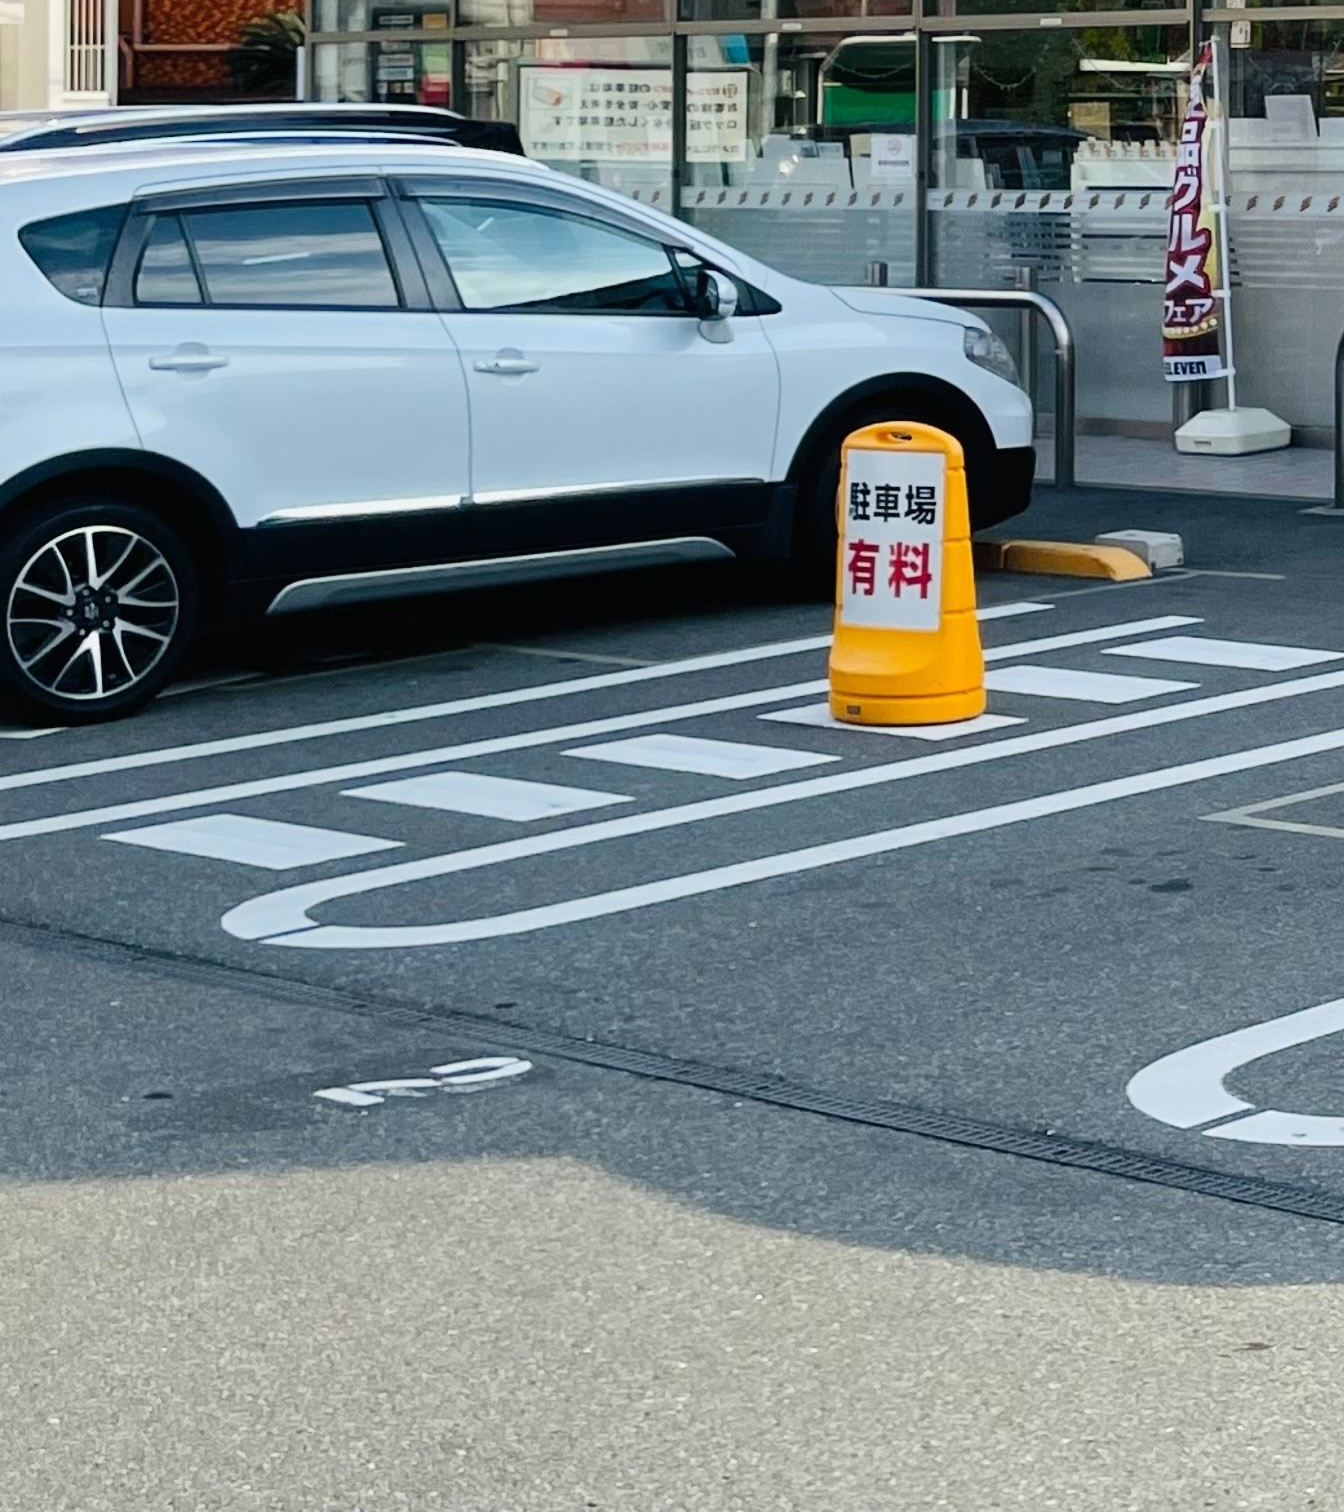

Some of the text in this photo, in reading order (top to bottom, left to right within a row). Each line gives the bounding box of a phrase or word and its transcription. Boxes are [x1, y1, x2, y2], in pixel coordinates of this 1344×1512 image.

[848, 481, 937, 525] 駐車場
[847, 538, 933, 600] 有料
